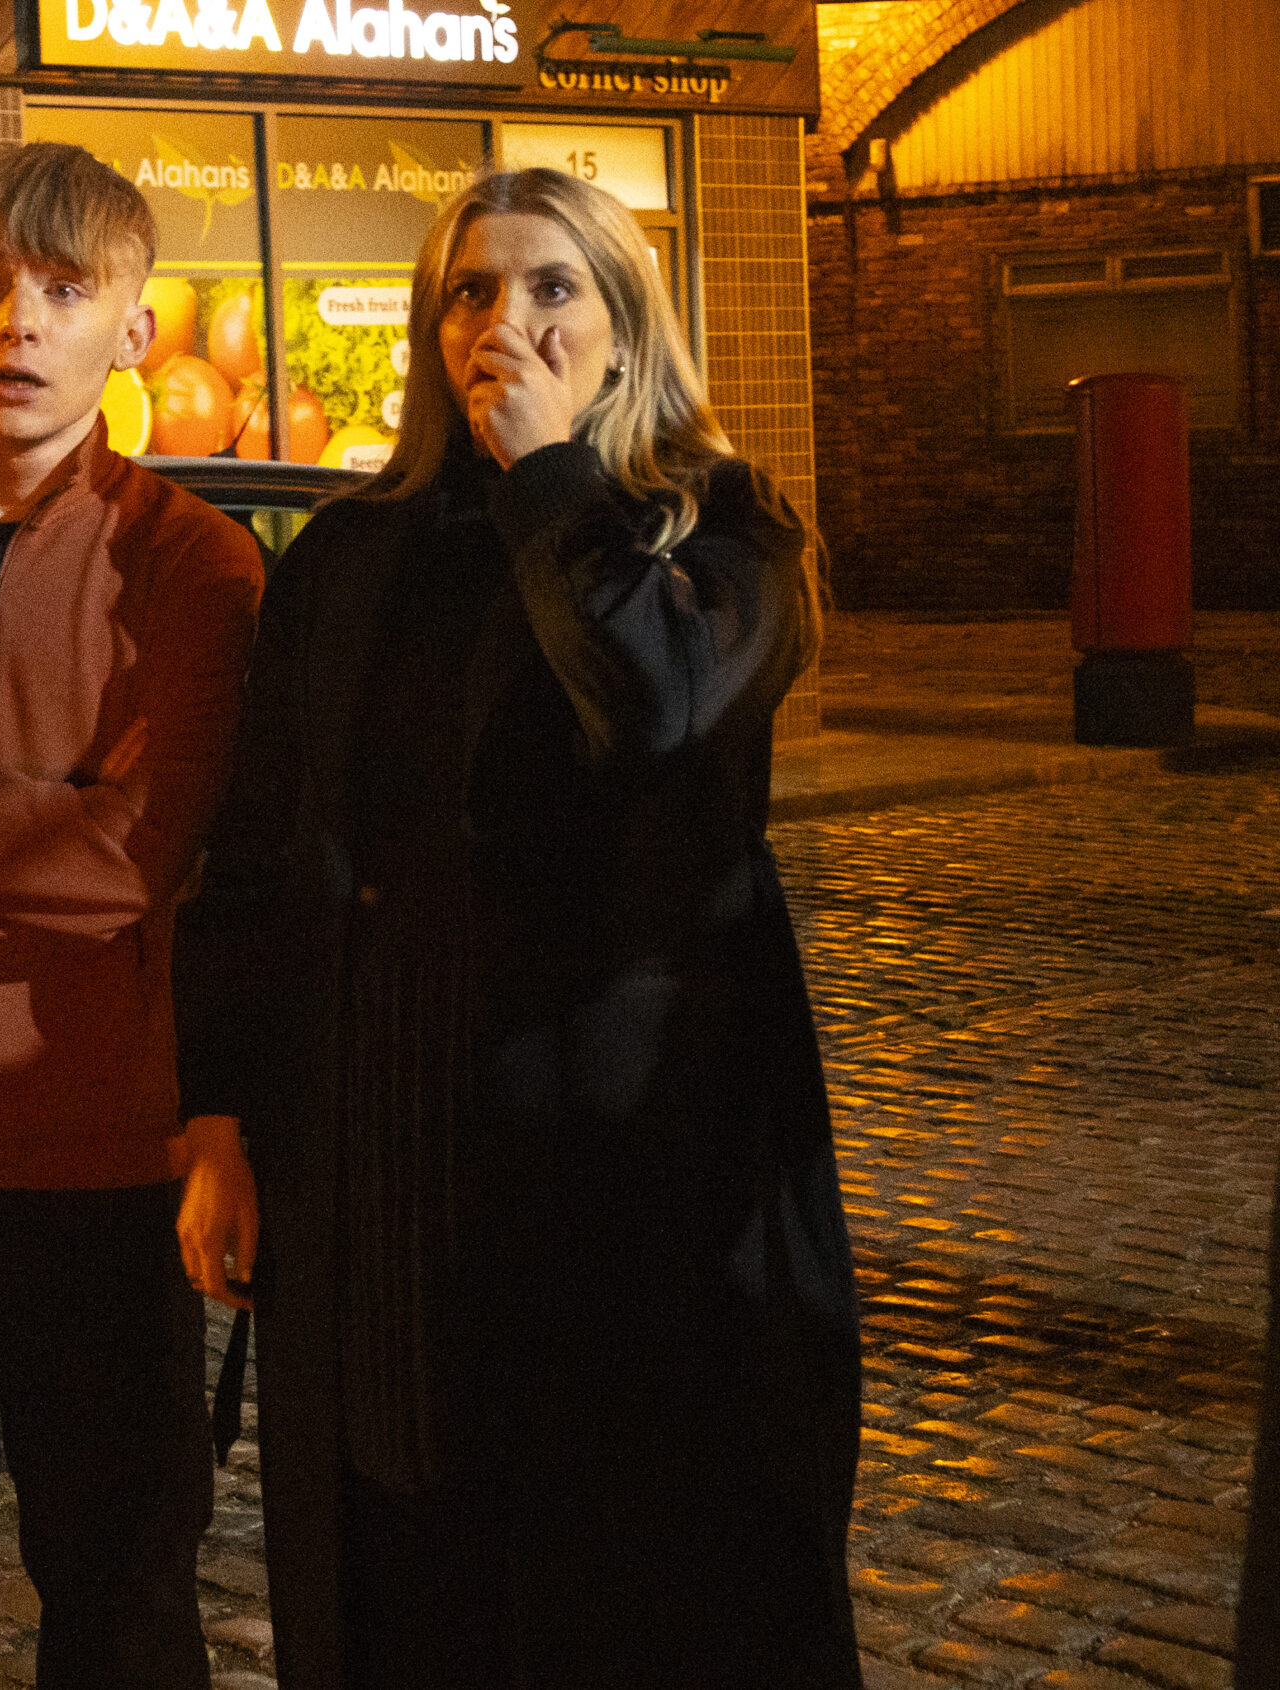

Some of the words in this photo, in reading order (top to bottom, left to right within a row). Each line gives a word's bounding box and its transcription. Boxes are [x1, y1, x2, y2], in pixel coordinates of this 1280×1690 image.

[66, 0, 282, 51] D&A&A
[538, 62, 644, 92] corner
[652, 60, 730, 103] shop
[277, 162, 366, 190] D&A&A
[566, 150, 598, 181] 15
[327, 297, 365, 312] Fresh
[368, 297, 398, 312] fruit
